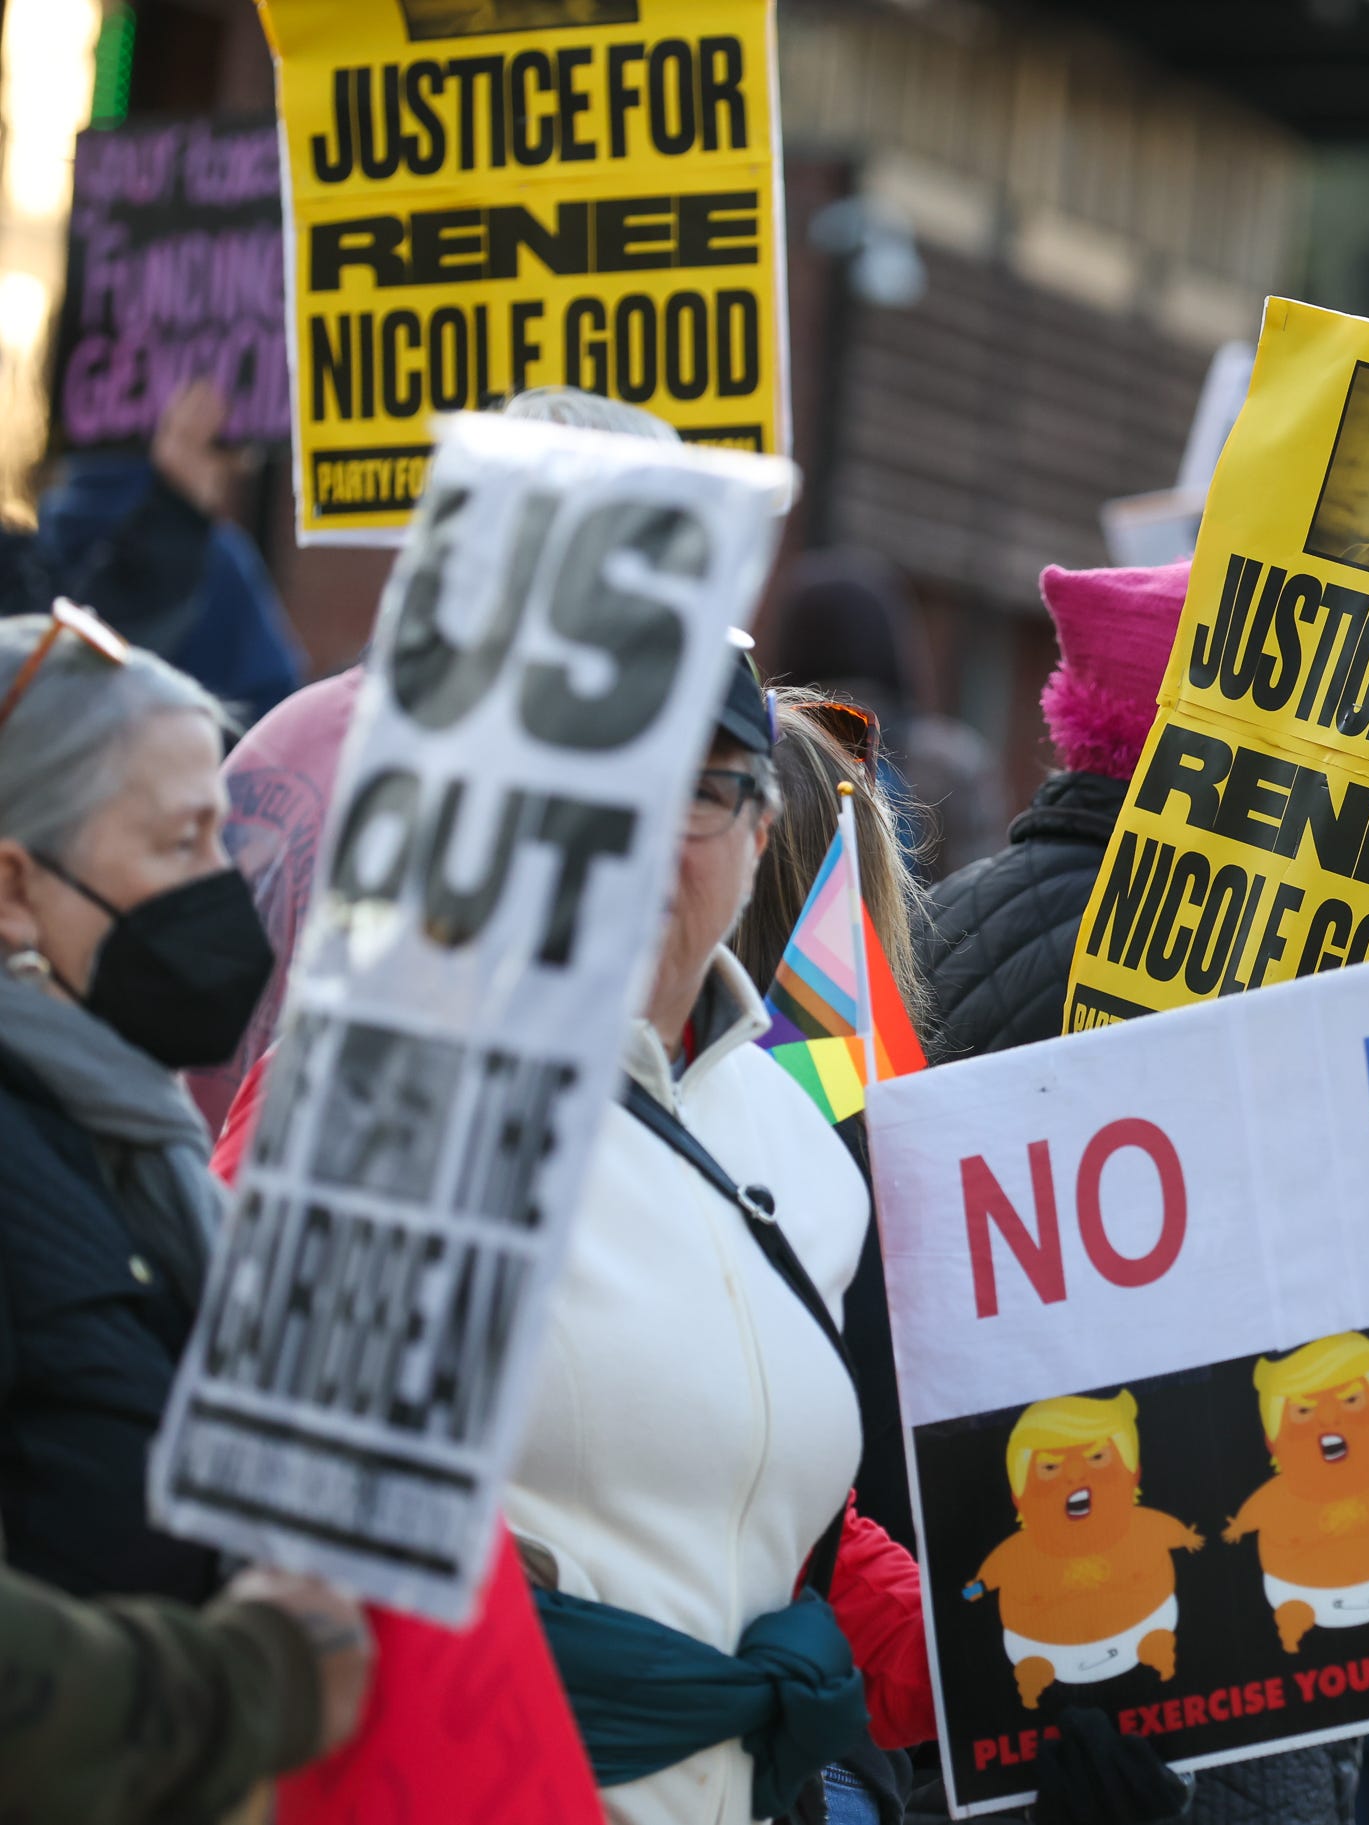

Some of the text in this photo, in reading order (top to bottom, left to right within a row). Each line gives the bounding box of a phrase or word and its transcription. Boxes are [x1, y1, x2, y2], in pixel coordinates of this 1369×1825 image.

[311, 46, 597, 184] JUSTICE
[607, 35, 749, 160] FOR
[308, 190, 760, 293] RENEE
[308, 288, 760, 422] NICOLE GOOD
[317, 457, 428, 502] PARTY FO
[388, 485, 716, 753] US
[330, 767, 639, 969] OUT
[1086, 831, 1306, 999] NICOLE
[959, 1117, 1189, 1320] NO
[1118, 1677, 1287, 1738] EXERCISE
